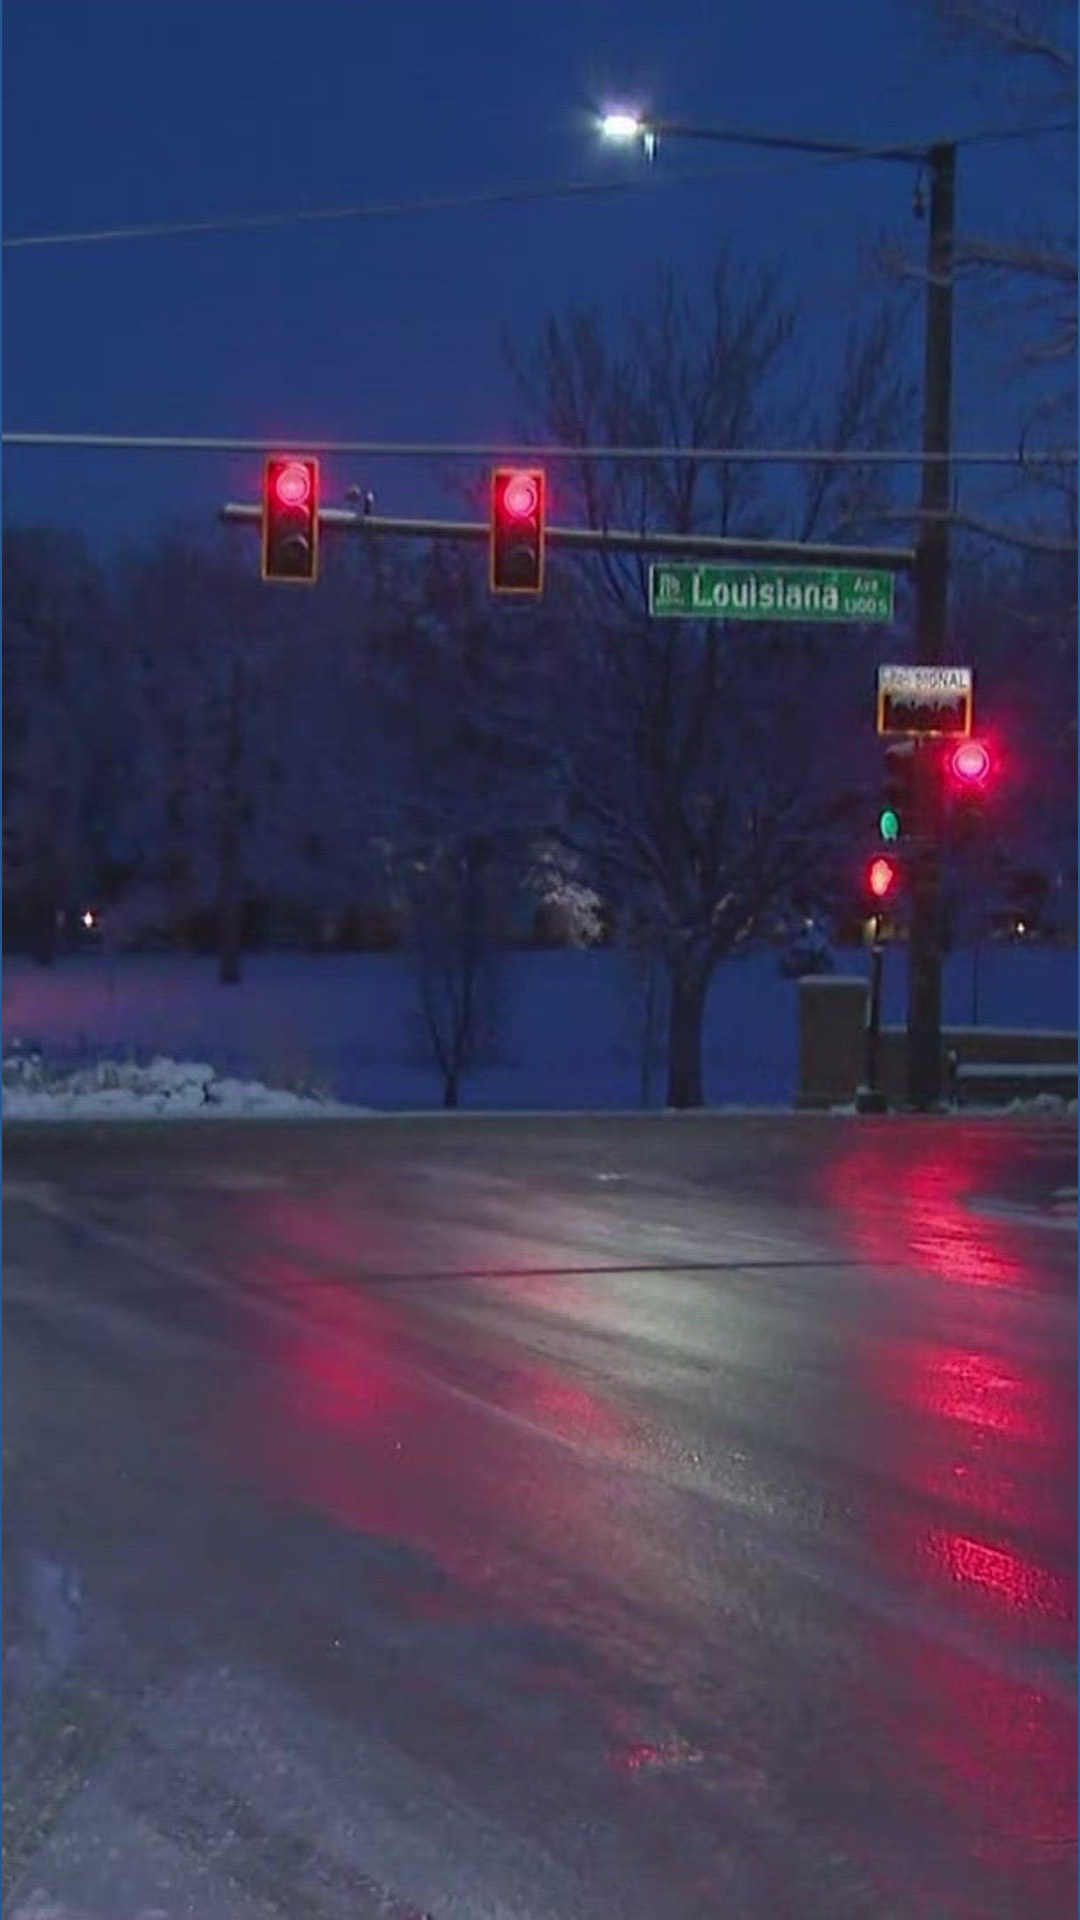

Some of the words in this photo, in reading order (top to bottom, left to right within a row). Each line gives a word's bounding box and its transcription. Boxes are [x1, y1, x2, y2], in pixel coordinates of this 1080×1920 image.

[692, 573, 839, 611] Louisiana
[854, 576, 879, 593] Ave
[915, 671, 968, 689] SIGNAL
